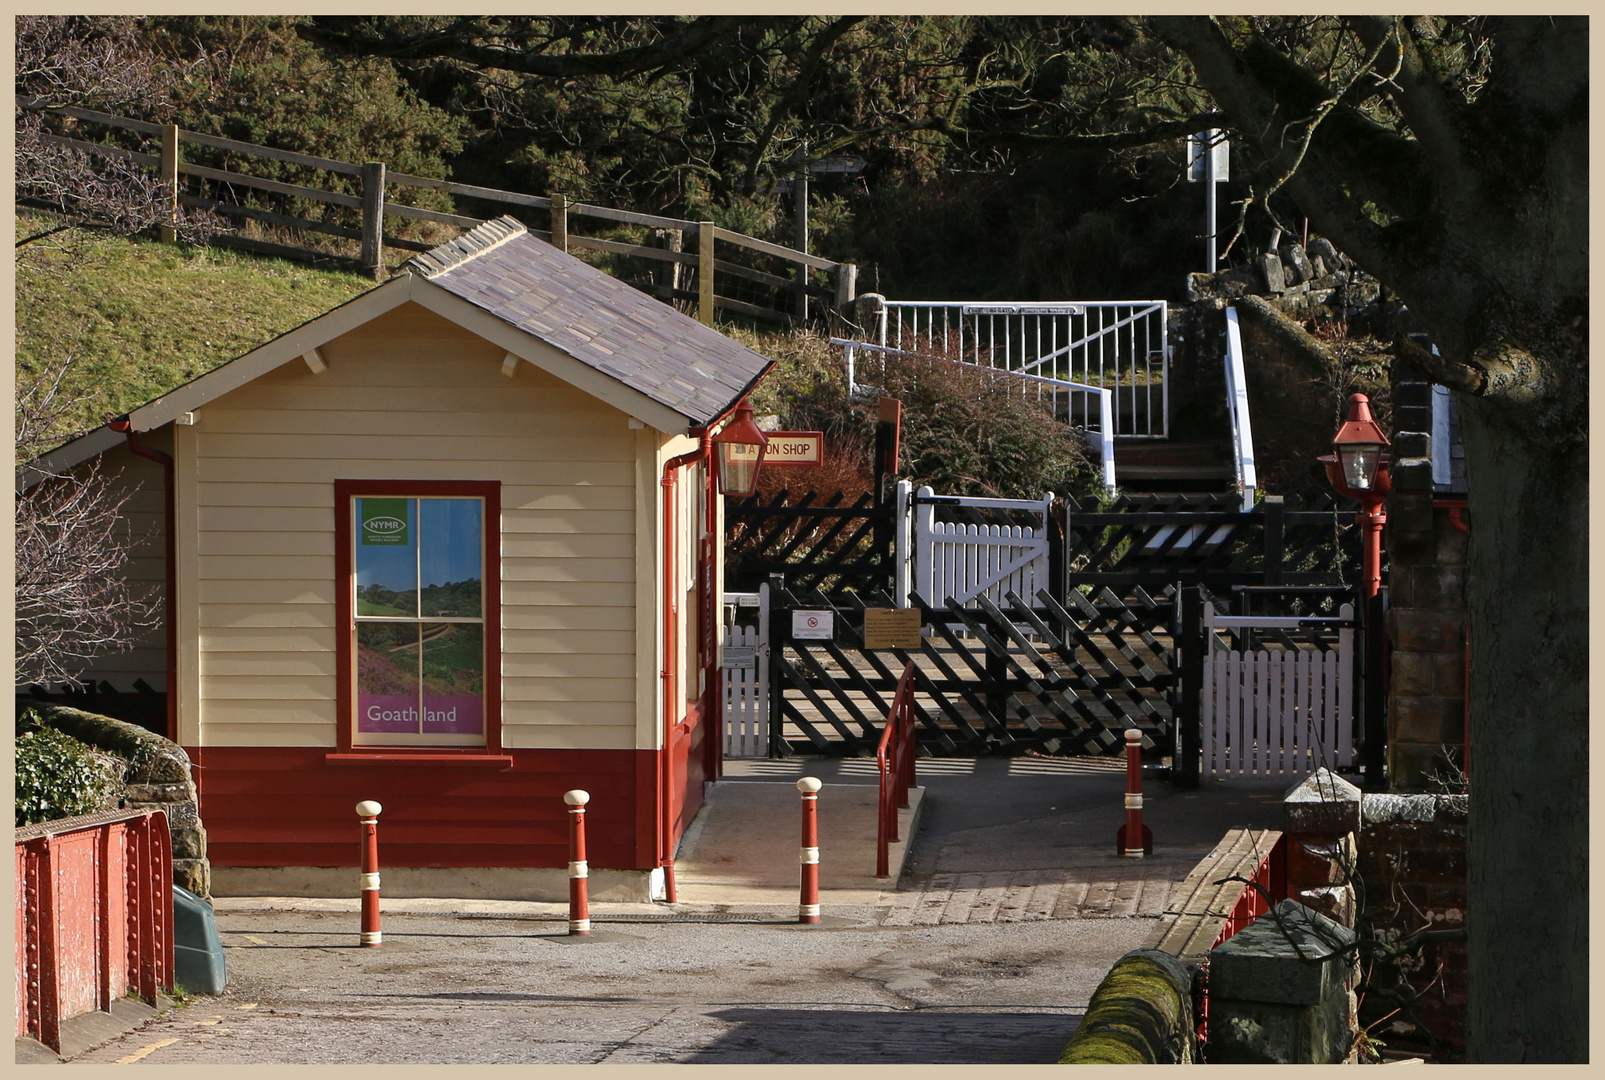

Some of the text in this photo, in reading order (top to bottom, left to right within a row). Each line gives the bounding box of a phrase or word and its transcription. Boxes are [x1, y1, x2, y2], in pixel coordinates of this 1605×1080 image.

[783, 443, 811, 455] SHOP
[370, 521, 399, 529] NYMR
[367, 705, 457, 722] Goathland
